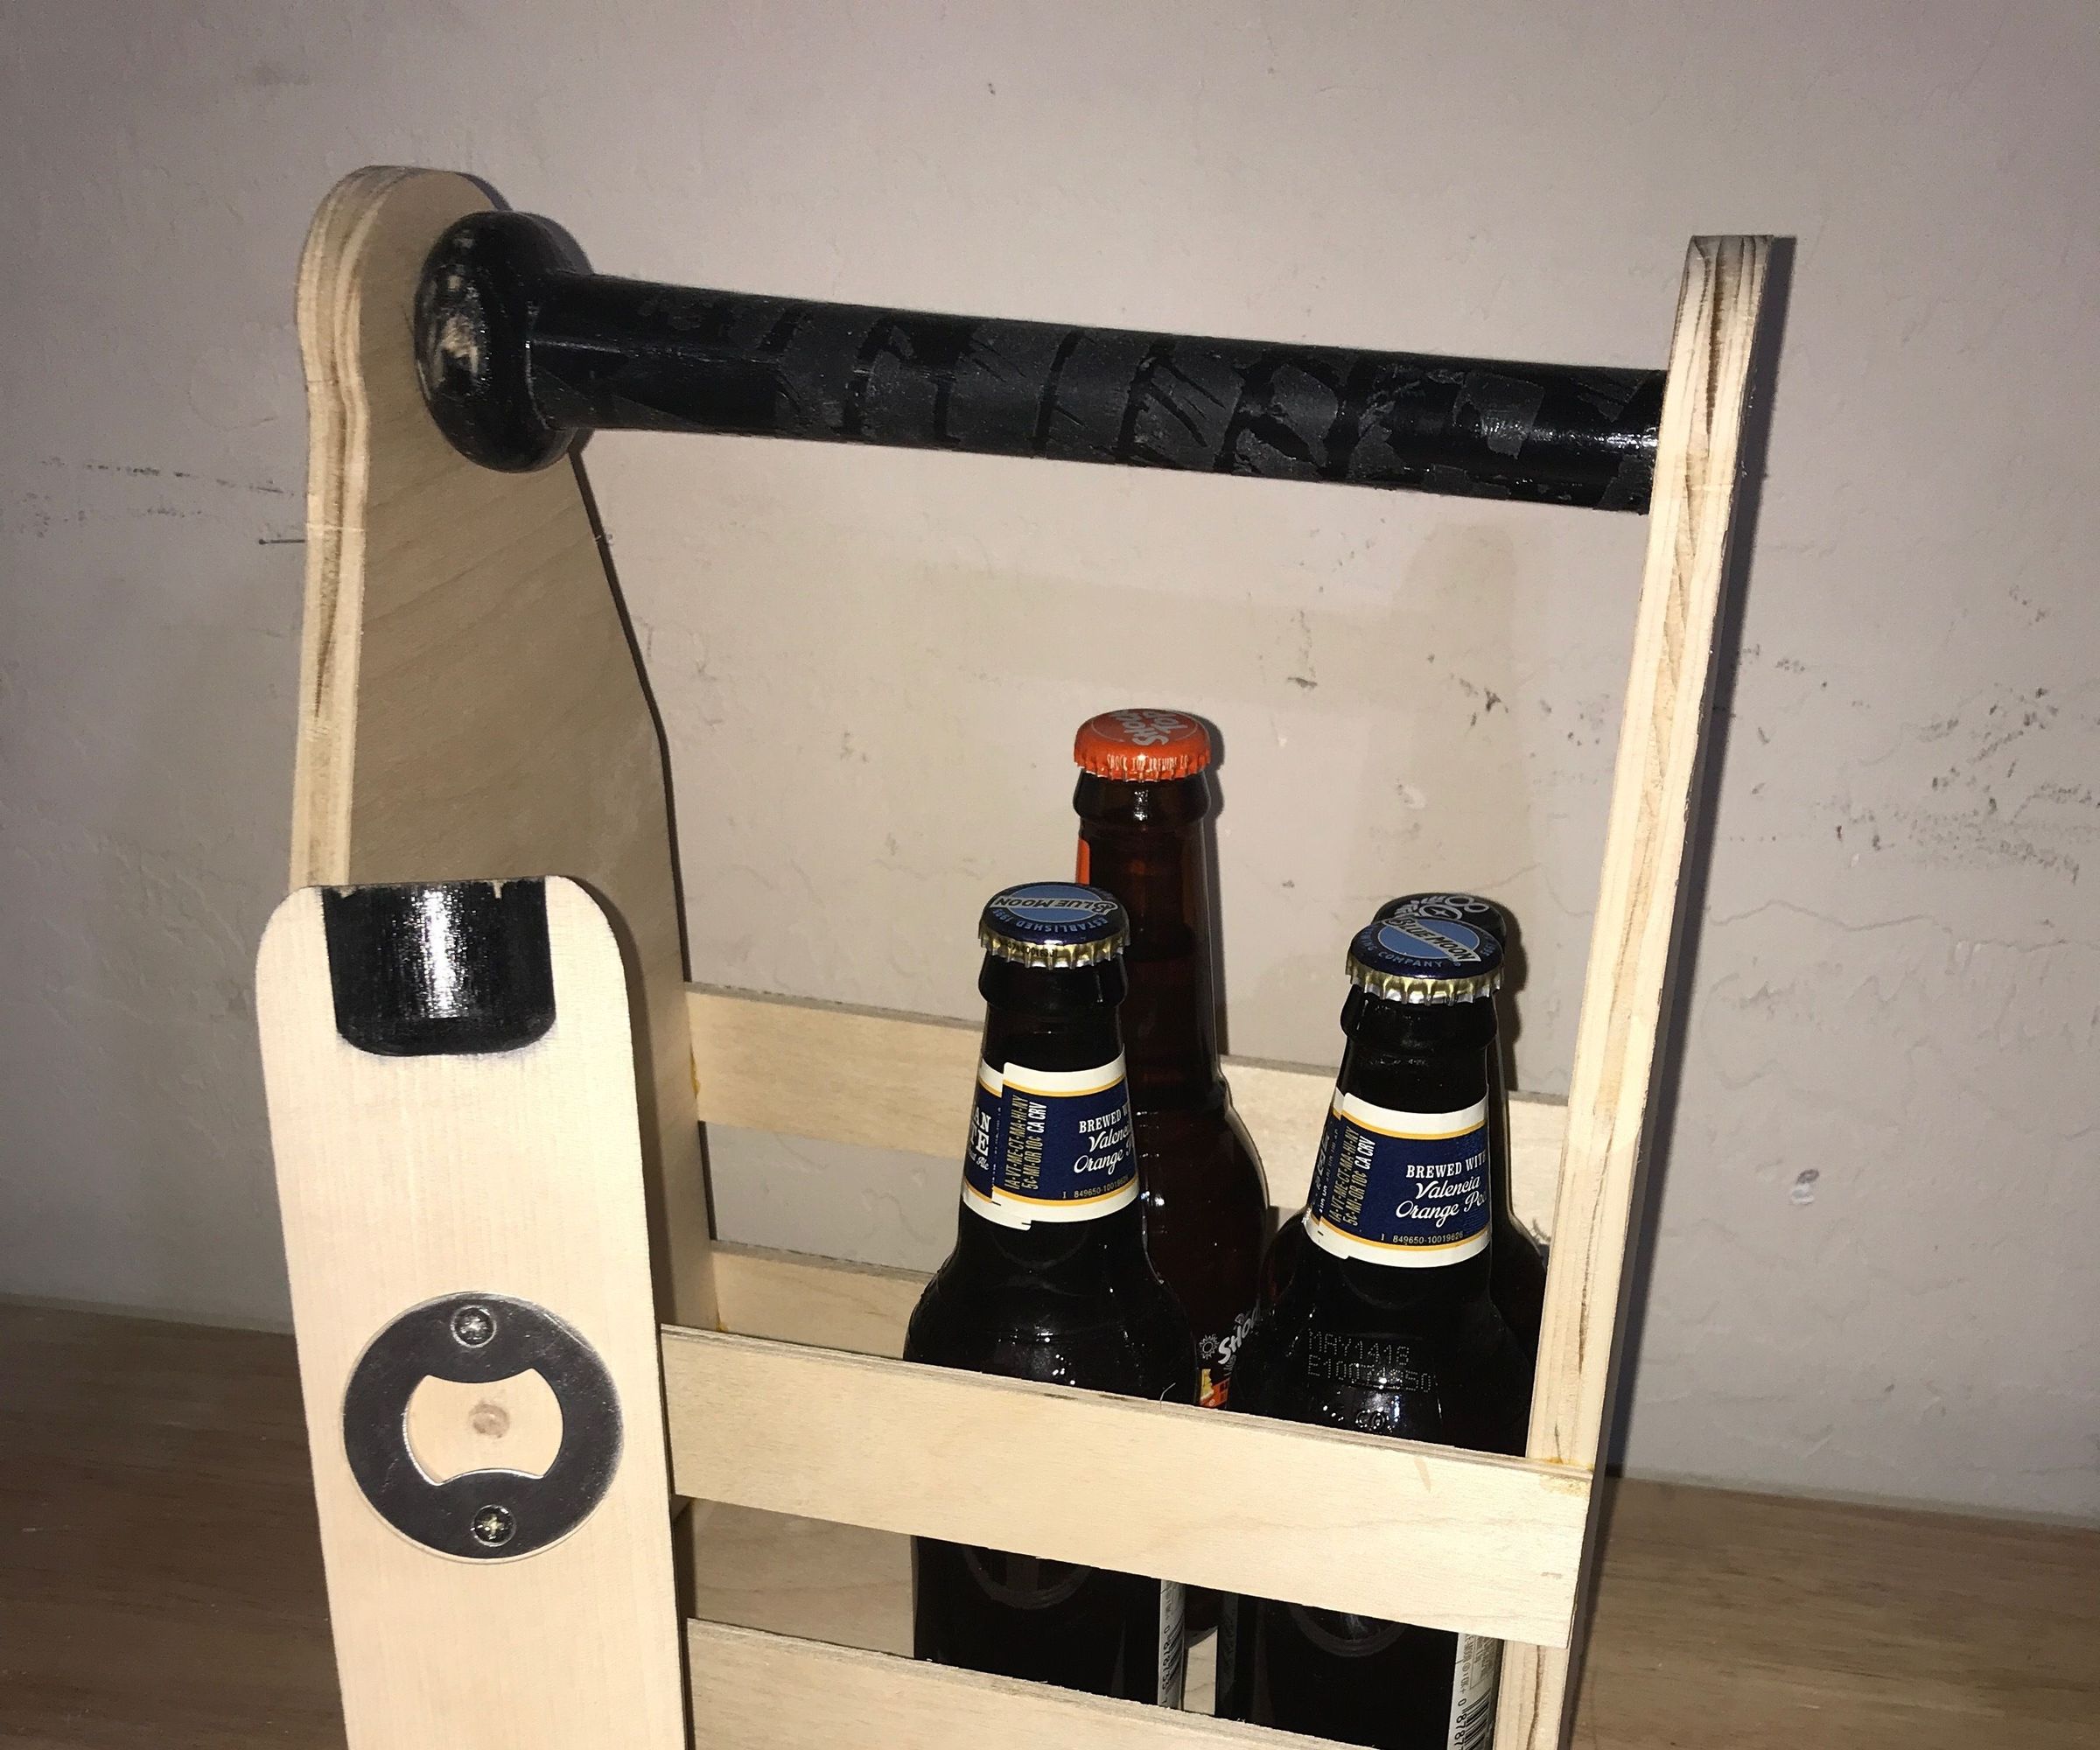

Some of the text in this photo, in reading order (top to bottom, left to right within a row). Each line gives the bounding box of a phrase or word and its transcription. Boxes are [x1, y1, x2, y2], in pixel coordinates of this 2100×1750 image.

[994, 897, 1116, 914] BLUE MOON
[1015, 917, 1109, 933] ESTABLISHED
[1389, 917, 1433, 941] BLUE
[1428, 935, 1477, 961] MOON
[1378, 951, 1443, 968] COMPANY
[1028, 1102, 1046, 1120] CRV
[1026, 1121, 1045, 1133] CA
[1079, 1109, 1121, 1133] BREWED
[1357, 1135, 1376, 1157] CRV
[1074, 1149, 1124, 1175] Orange
[1354, 1156, 1372, 1169] CA
[1405, 1162, 1462, 1179] BREWED
[1416, 1176, 1480, 1199] Valencia
[1396, 1200, 1460, 1228] Orange
